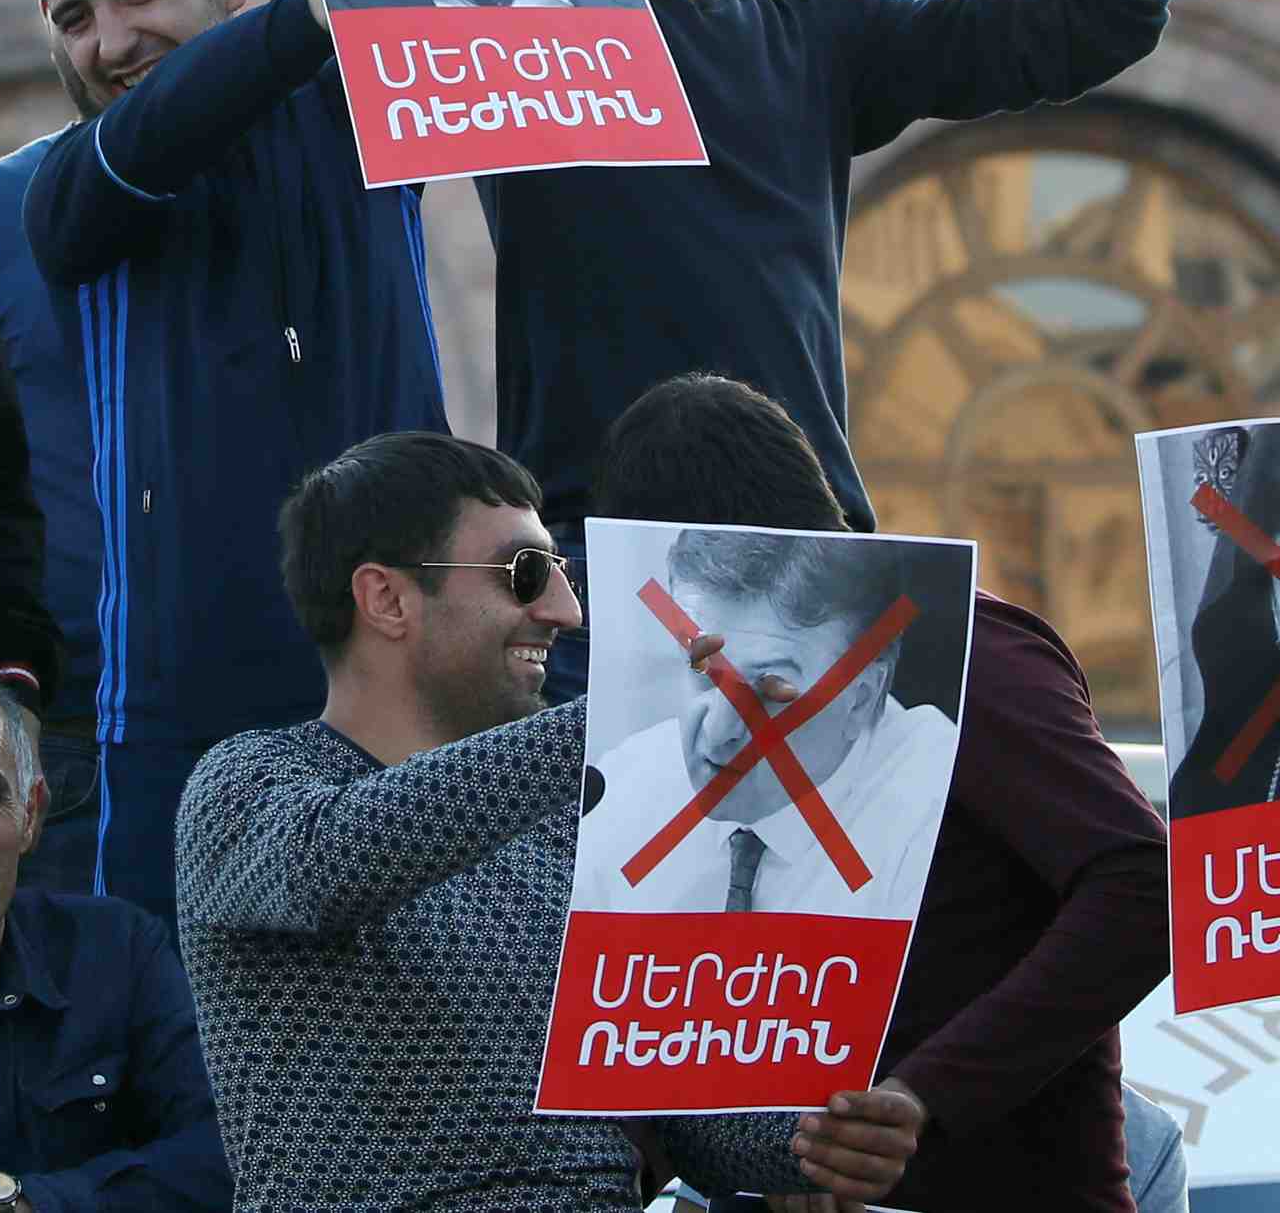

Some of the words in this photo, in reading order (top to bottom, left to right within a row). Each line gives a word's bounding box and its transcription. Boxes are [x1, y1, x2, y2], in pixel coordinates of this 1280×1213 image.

[371, 37, 633, 89] ՄԵՐԺԻՐ
[386, 89, 664, 141] ՌԵԺԻՄԻՆ
[591, 952, 859, 1009] ՄԵՐԺԻՐ
[577, 1018, 851, 1067] ՌԵԺԻՄԻՆ
